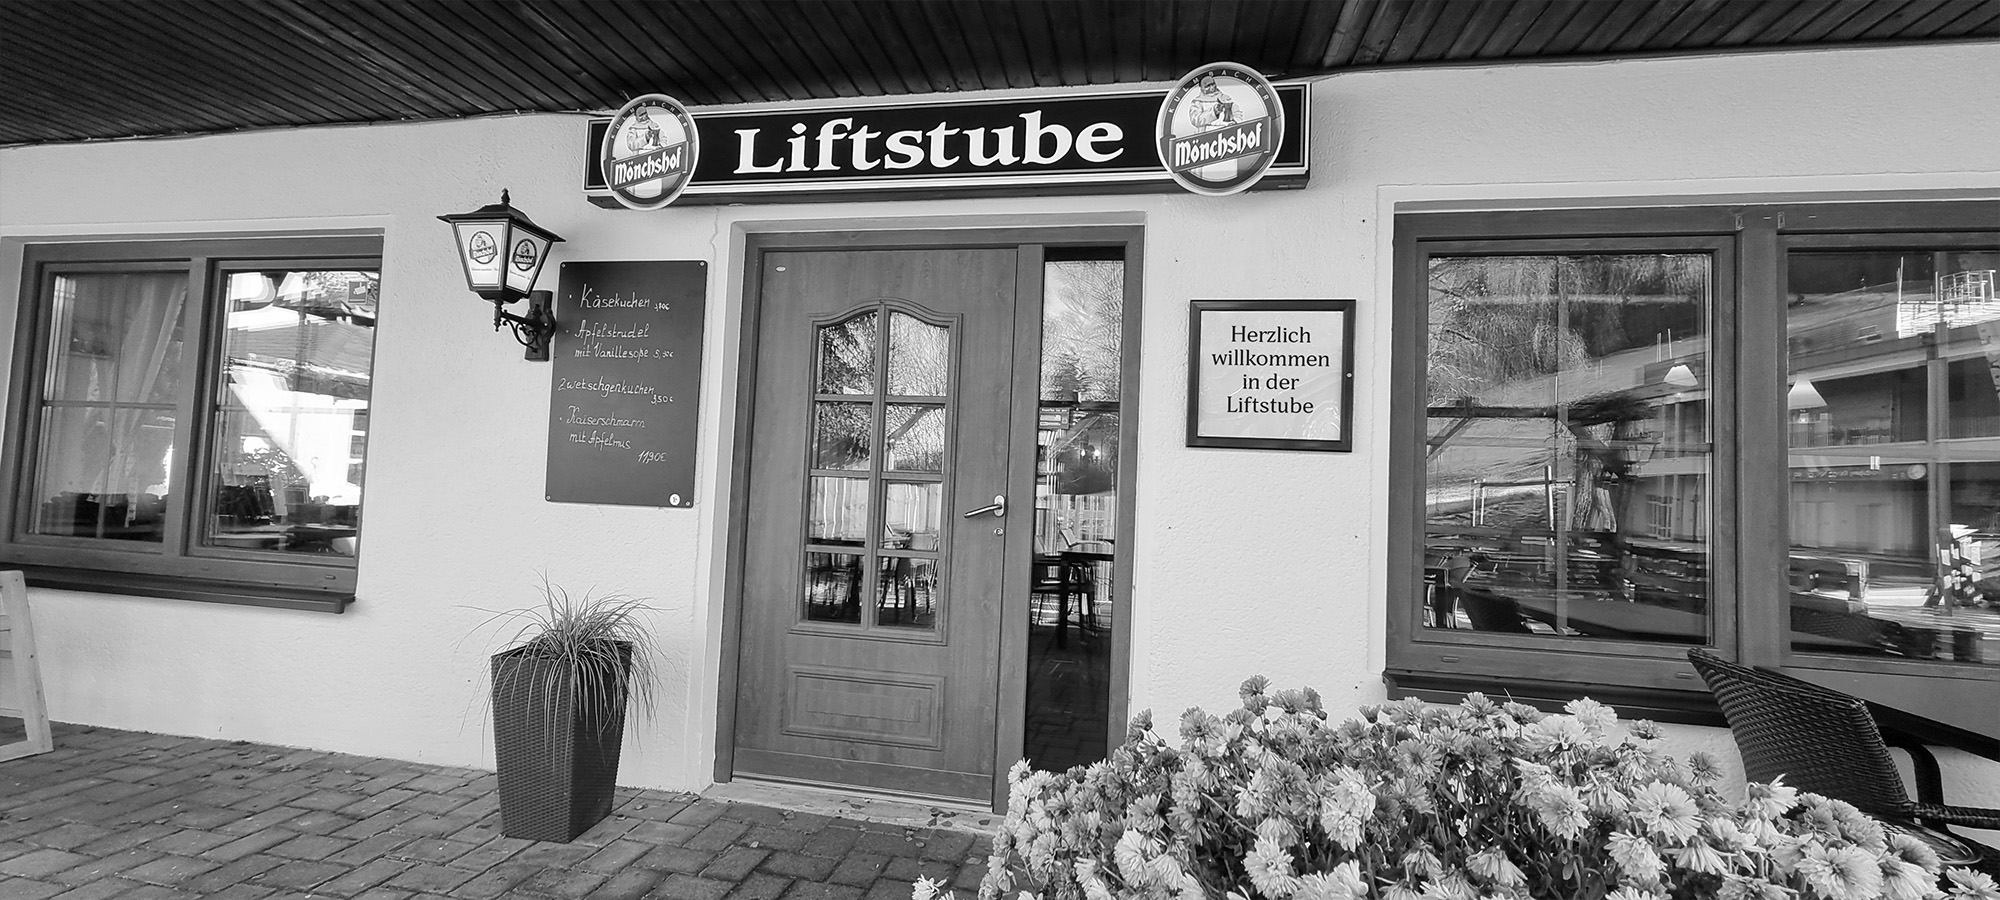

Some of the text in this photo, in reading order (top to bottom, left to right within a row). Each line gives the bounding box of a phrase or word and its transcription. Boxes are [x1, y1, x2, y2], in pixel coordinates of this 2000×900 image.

[1168, 70, 1269, 114] KULMBACHER
[733, 109, 1124, 174] Liftstube
[1175, 121, 1262, 167] Mönchshof
[614, 146, 682, 185] Mönchshof
[580, 283, 650, 308] Käsekuchen
[574, 319, 649, 345] Apfelstrudel
[1231, 325, 1311, 343] Herzlich
[574, 344, 591, 358] mit
[593, 341, 649, 363] Vanillesoße
[1212, 349, 1330, 367] willkommen
[1243, 373, 1300, 390] in der
[1226, 396, 1314, 413] Liftstube
[569, 430, 631, 451] mit Apfelmus
[637, 450, 667, 464] 11,90€
